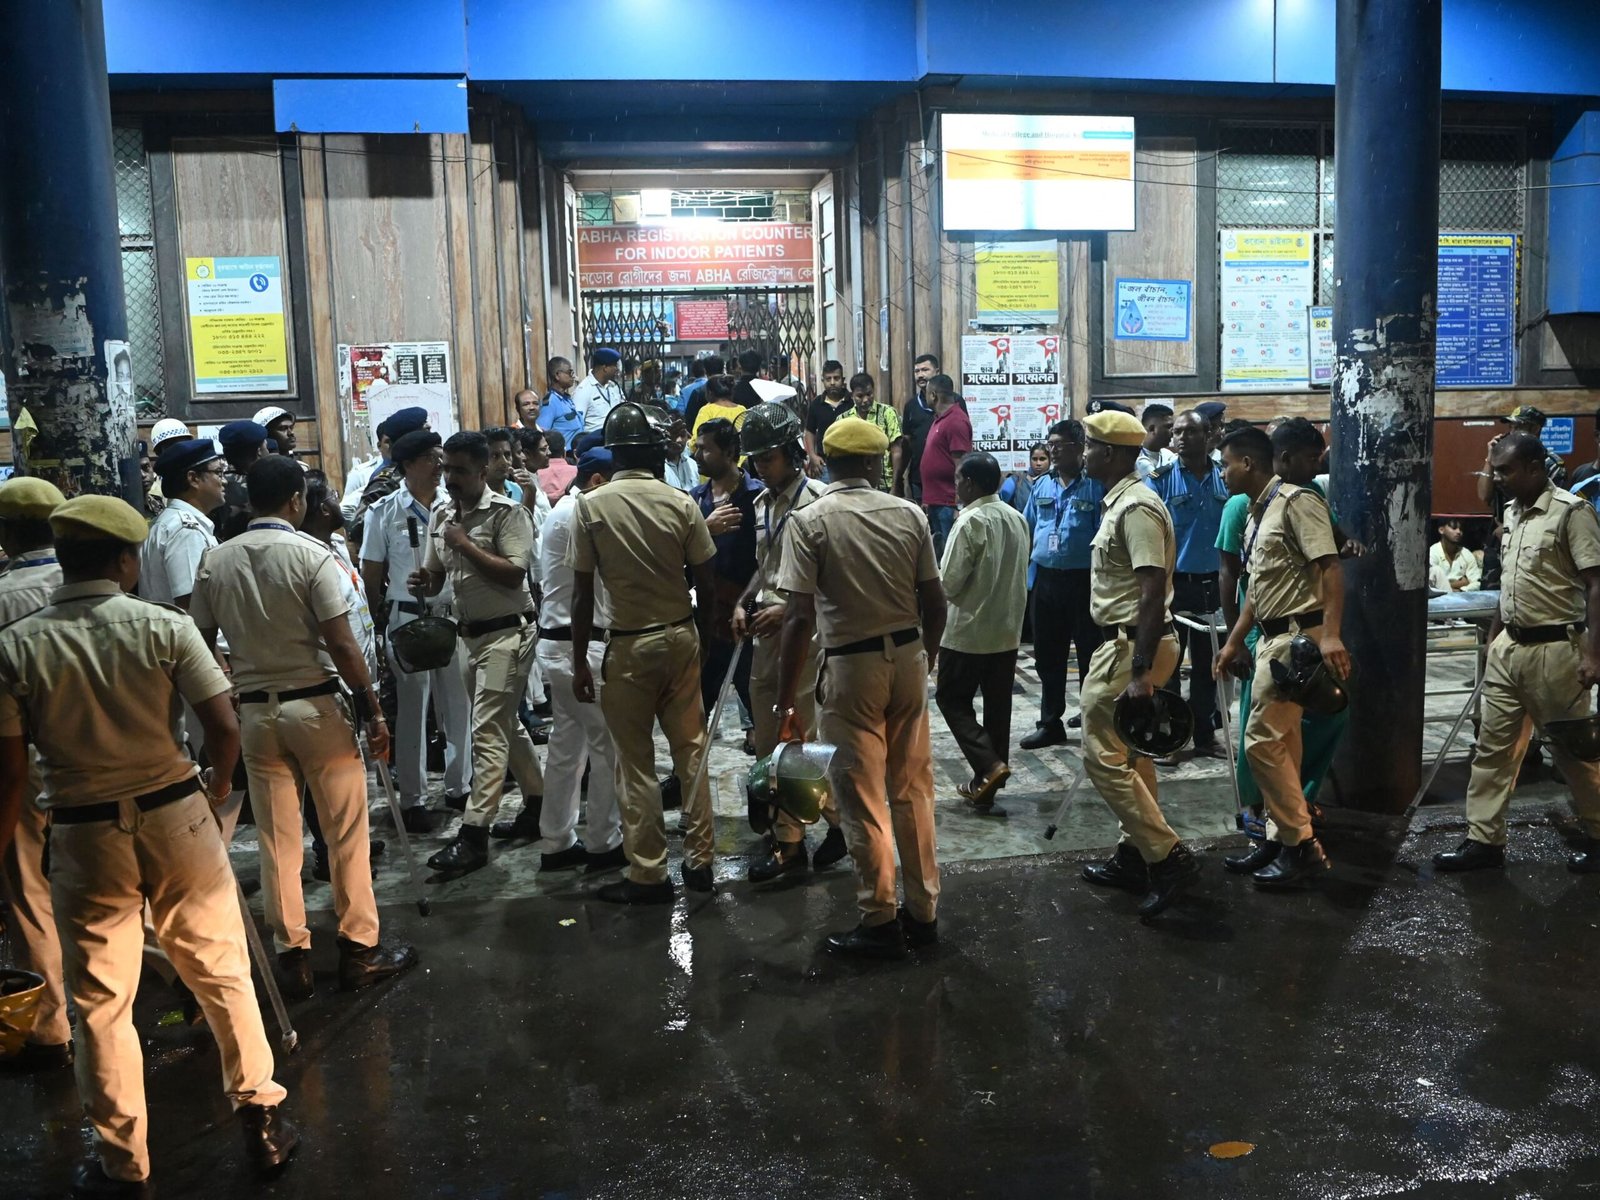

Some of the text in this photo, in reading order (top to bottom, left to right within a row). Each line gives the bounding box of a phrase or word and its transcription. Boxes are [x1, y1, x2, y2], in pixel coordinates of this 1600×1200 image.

[579, 230, 623, 244] ABHA
[741, 226, 813, 240] COUNTER
[615, 244, 785, 261] FOR INDOOR PATIENTS
[580, 272, 614, 286] নডোর
[618, 266, 663, 285] রোগীদের
[667, 270, 692, 283] জন্য
[695, 268, 732, 283] ABHA
[967, 373, 1007, 385] সম্মেলন
[1016, 373, 1055, 385] সম্মেলন
